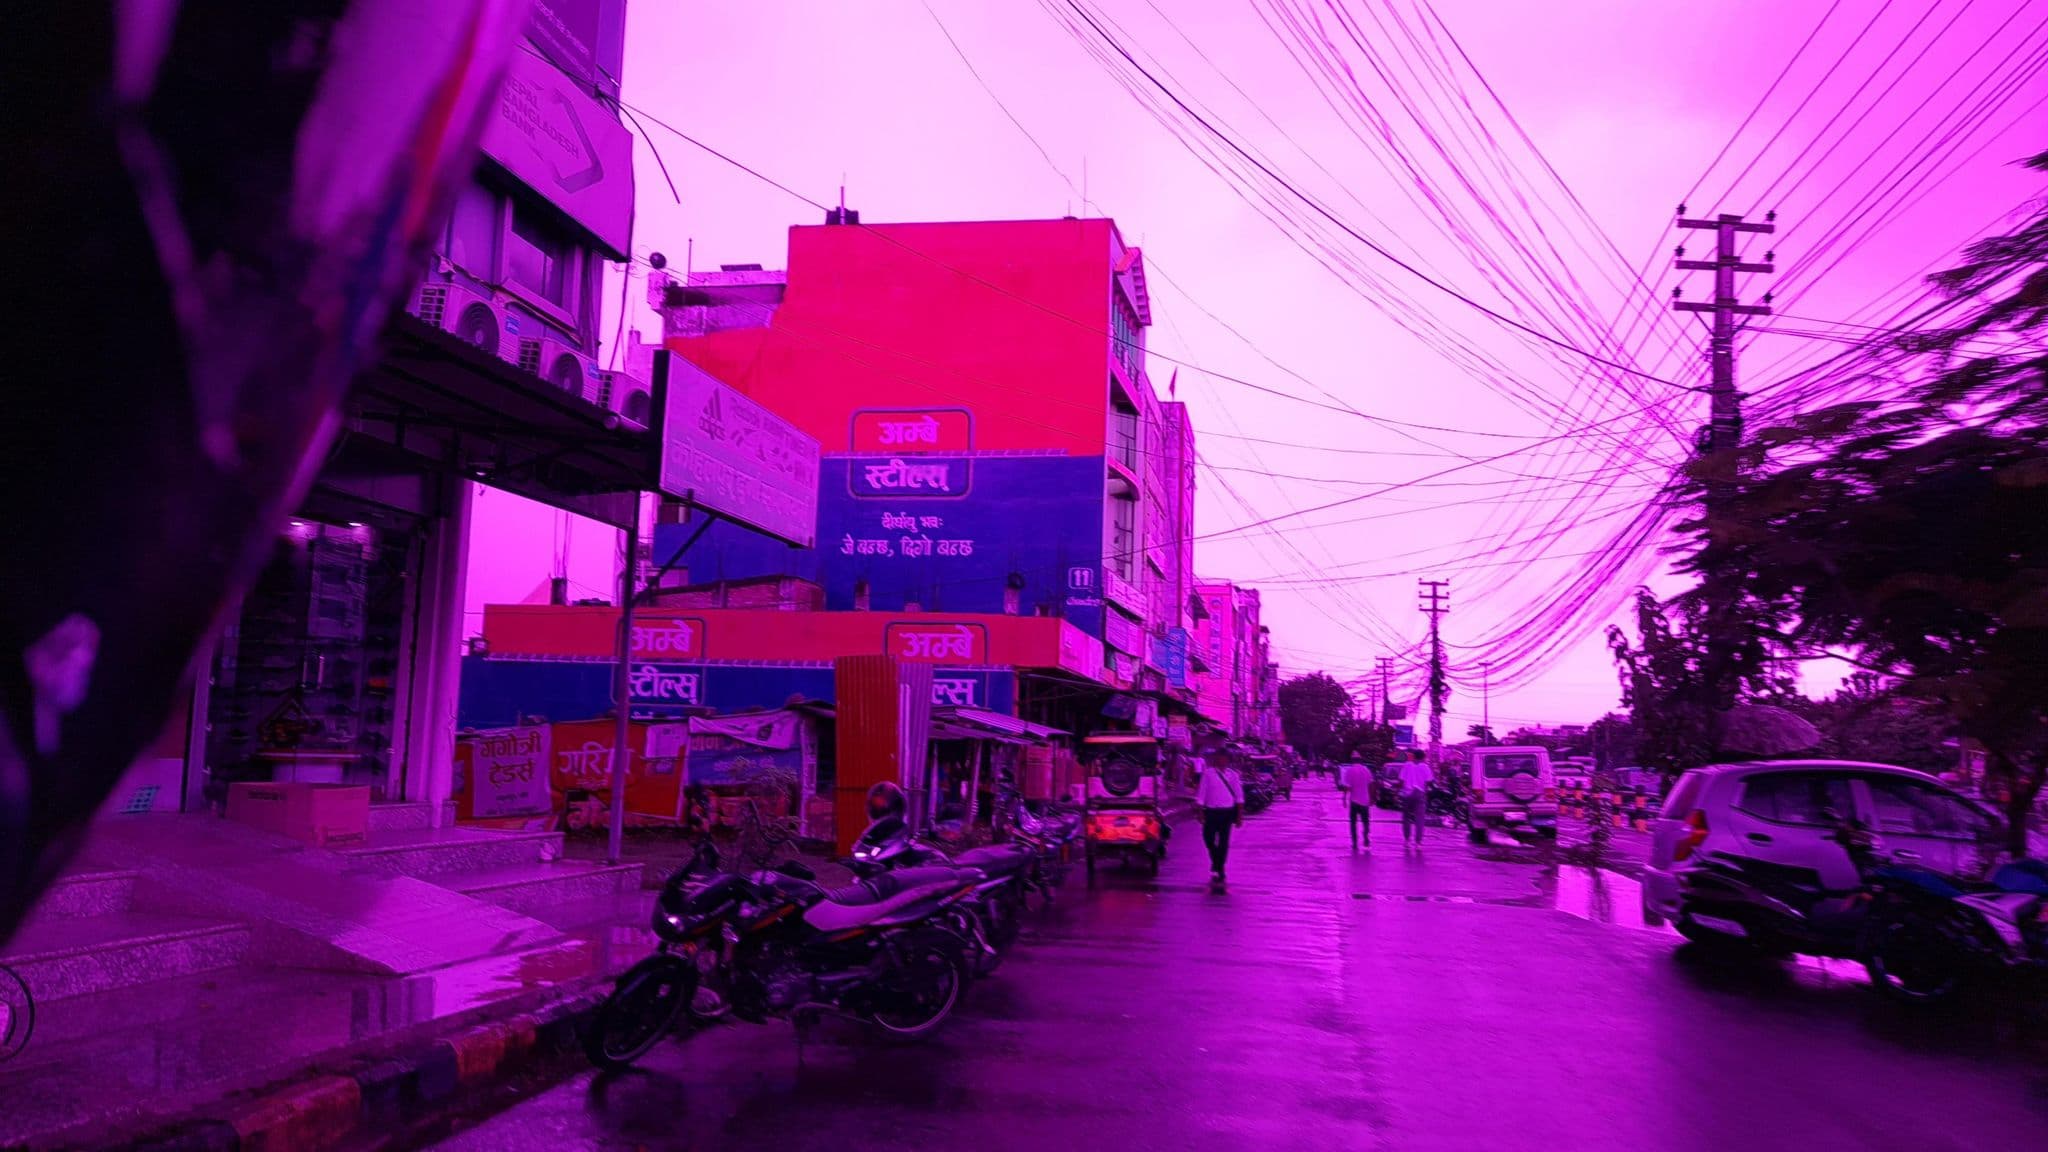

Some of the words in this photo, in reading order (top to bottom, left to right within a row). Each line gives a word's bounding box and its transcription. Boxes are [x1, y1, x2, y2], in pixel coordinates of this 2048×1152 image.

[503, 103, 536, 141] BANK
[503, 87, 579, 159] BANGLADESH
[877, 414, 941, 445] अम्बे
[936, 539, 975, 556] बन्छ
[1072, 569, 1089, 587] 11
[631, 618, 694, 653] अम्बे
[898, 623, 976, 660] अम्बे
